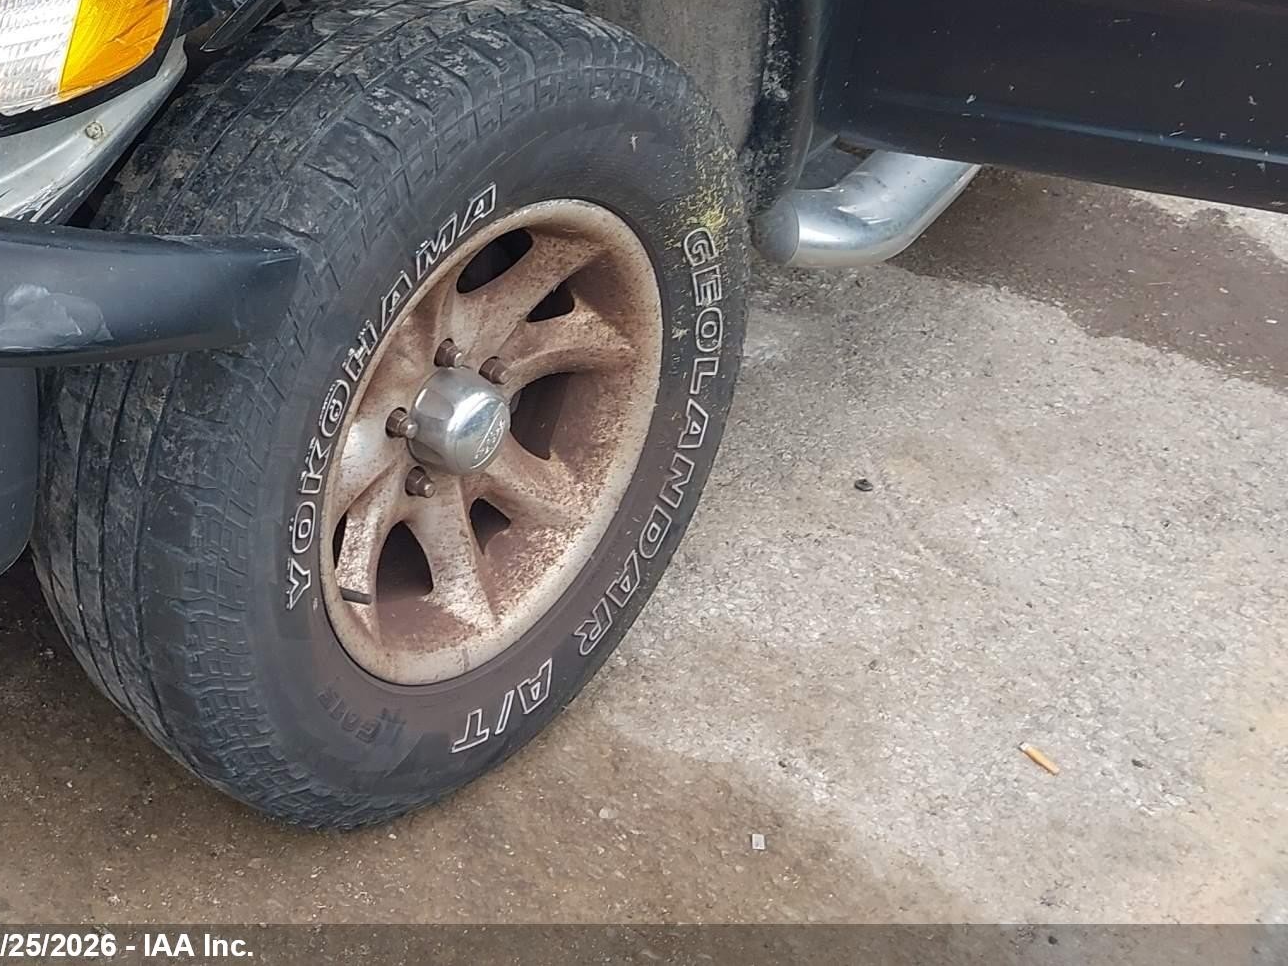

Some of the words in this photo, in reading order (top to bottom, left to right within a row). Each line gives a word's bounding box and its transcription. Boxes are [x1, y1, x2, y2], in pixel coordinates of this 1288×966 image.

[285, 182, 497, 611] YOKOHAMA
[574, 226, 724, 657] GEOLANDAR
[450, 657, 553, 753] A/T
